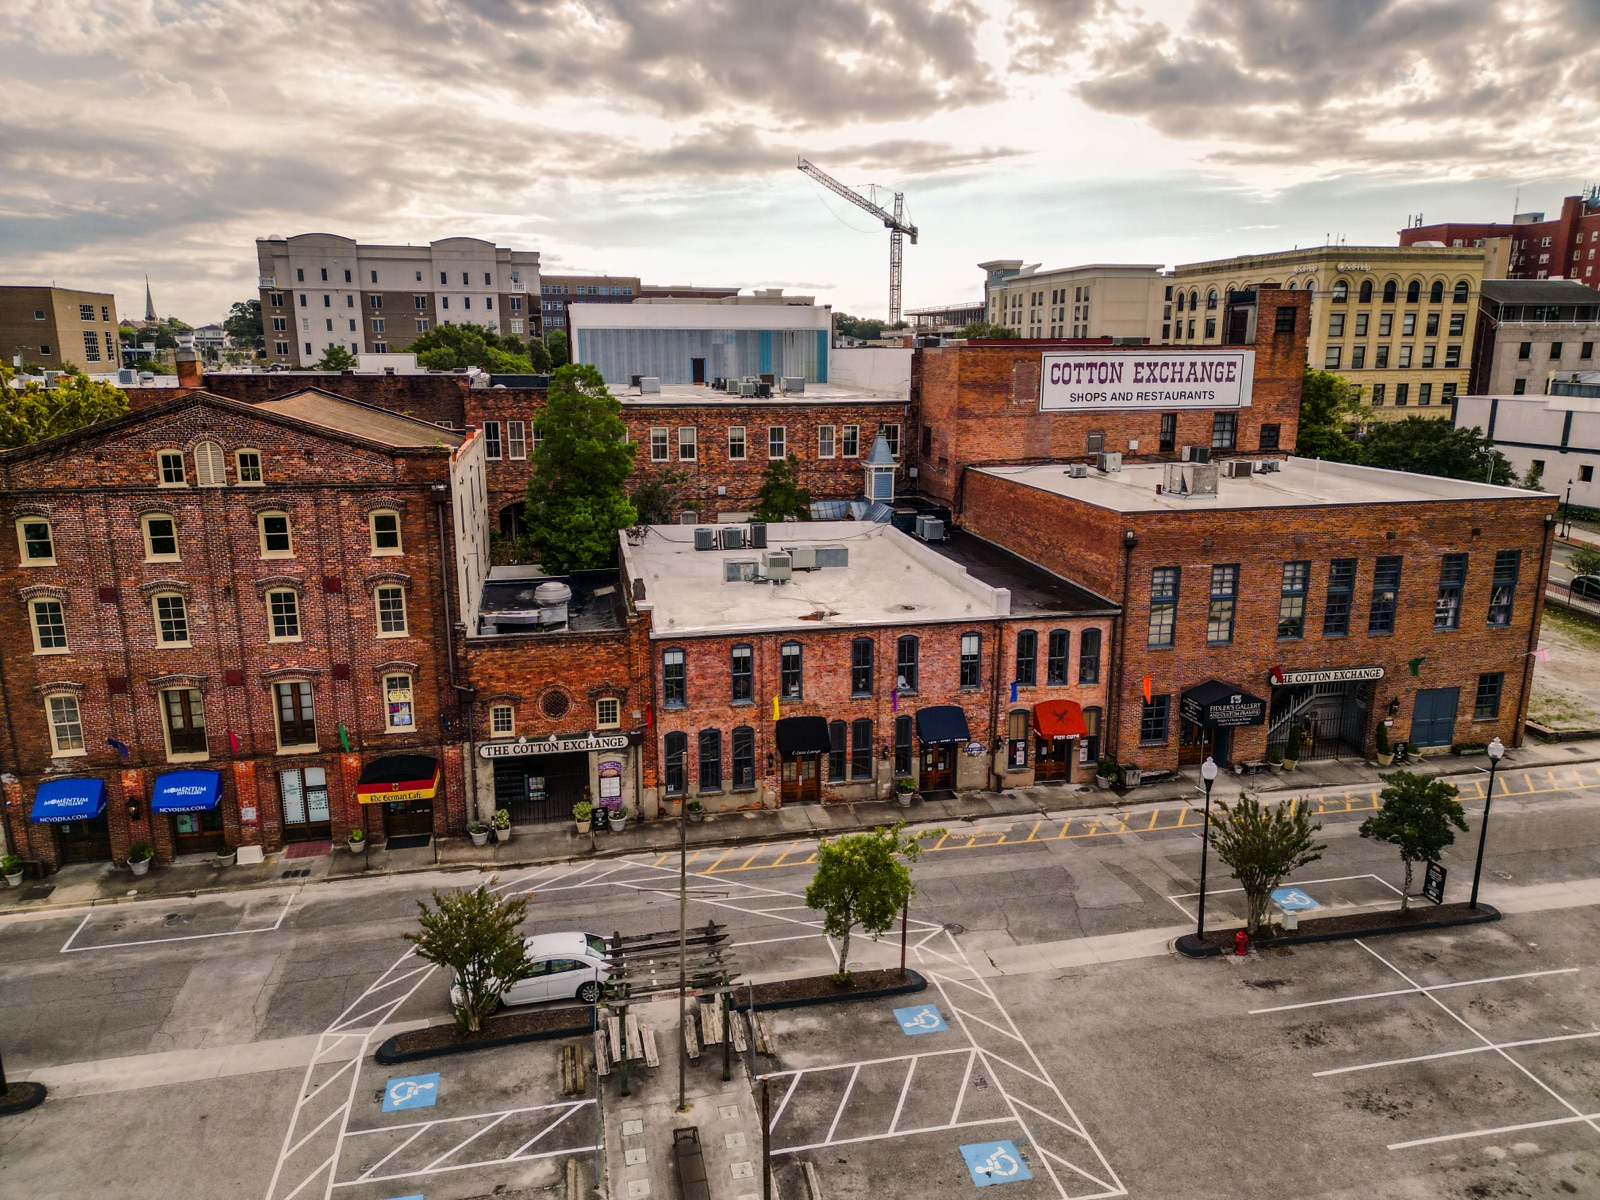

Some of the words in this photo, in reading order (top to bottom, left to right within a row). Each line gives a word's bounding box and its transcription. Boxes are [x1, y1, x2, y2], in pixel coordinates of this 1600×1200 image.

[1050, 361, 1124, 385] COTTON
[1132, 361, 1237, 383] EXCHANGE
[1069, 393, 1107, 402] SHOPS
[1110, 393, 1134, 402] AND
[1136, 391, 1215, 401] RESTAURANTS
[1295, 672, 1331, 682] COTTON
[1334, 669, 1380, 680] EXCHANGE
[485, 746, 509, 756] THE
[513, 742, 559, 754] COTTON
[563, 738, 624, 751] EXCHANGE
[383, 793, 407, 801] German
[159, 805, 206, 813] NCVODKA.COM
[40, 814, 88, 823] NCVODKA.COM
